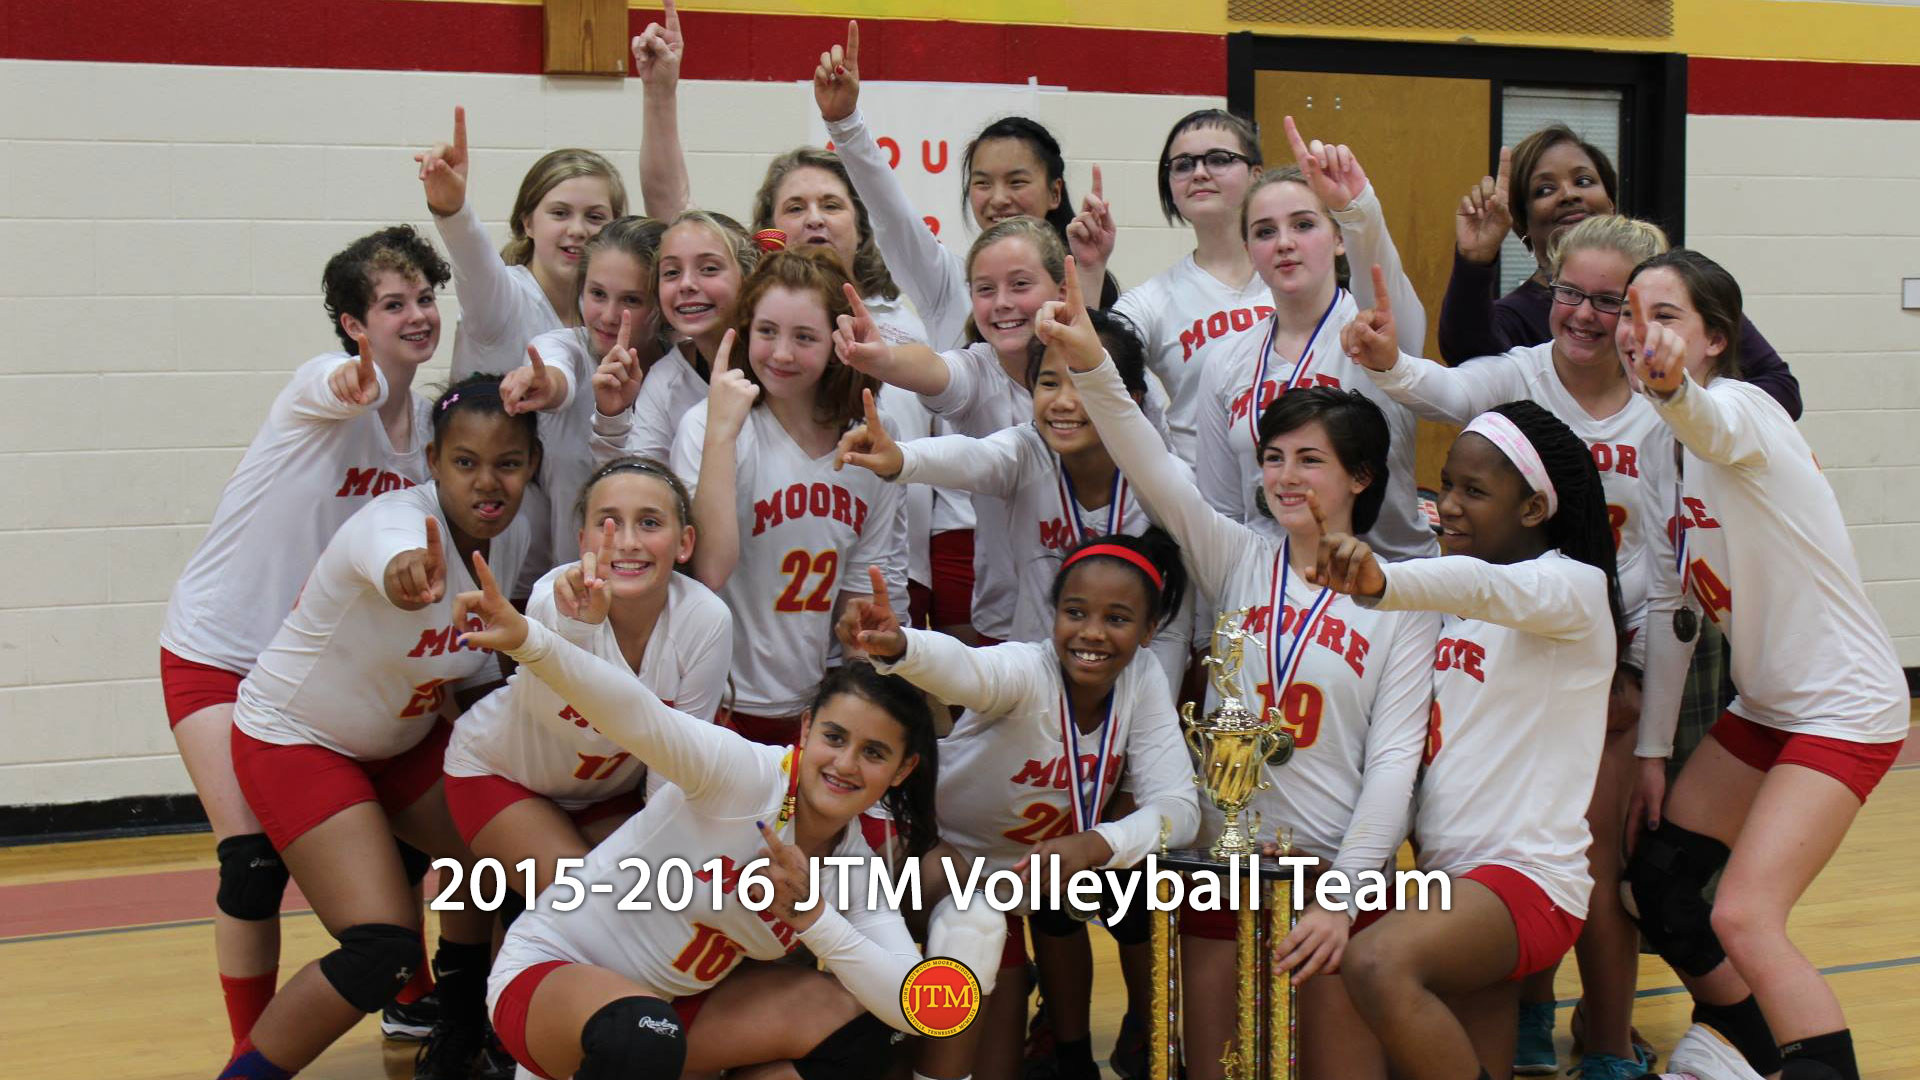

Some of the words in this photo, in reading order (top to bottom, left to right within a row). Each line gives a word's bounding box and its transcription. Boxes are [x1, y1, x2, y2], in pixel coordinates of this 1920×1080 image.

[775, 548, 838, 613] 22
[1256, 681, 1325, 749] 19
[672, 921, 748, 983] 16
